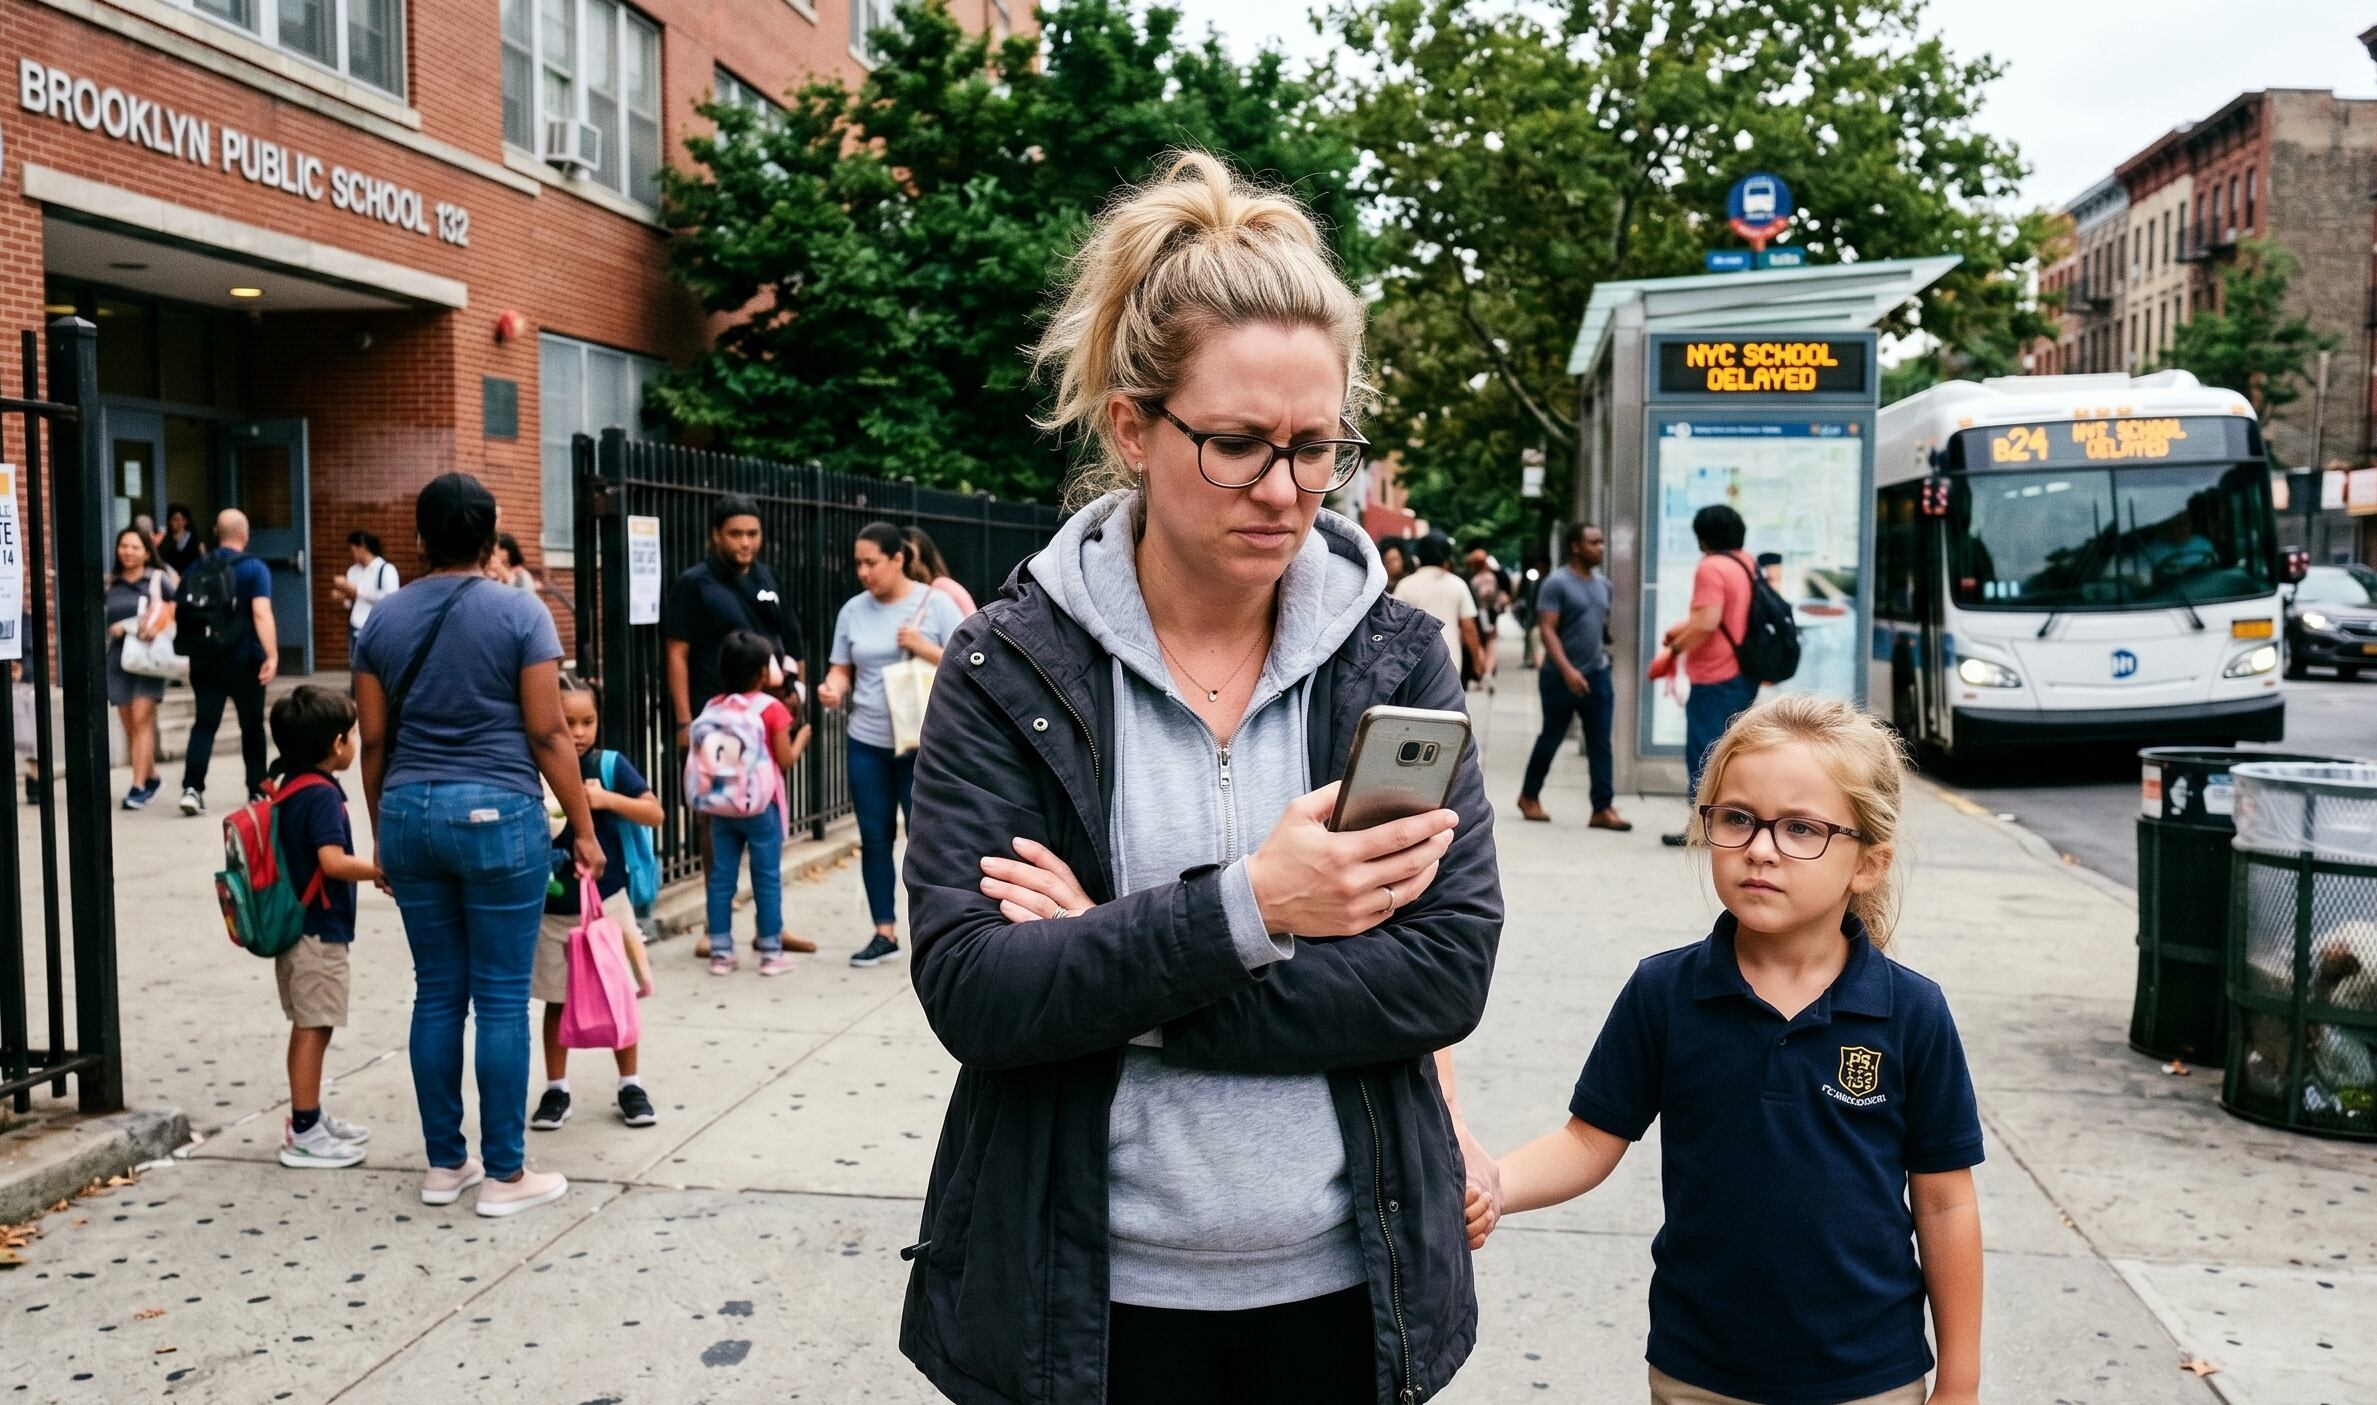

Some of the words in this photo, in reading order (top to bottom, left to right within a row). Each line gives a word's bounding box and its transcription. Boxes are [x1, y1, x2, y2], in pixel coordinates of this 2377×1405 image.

[19, 57, 211, 167] BROOKLYN
[220, 126, 324, 201] PUBLIC
[330, 166, 430, 236] SCHOOL
[435, 201, 470, 248] 132
[1687, 343, 1736, 367] NYC
[1743, 343, 1838, 366] SCHOOL
[1706, 366, 1817, 391] DELAYED
[1993, 427, 2048, 461] B24
